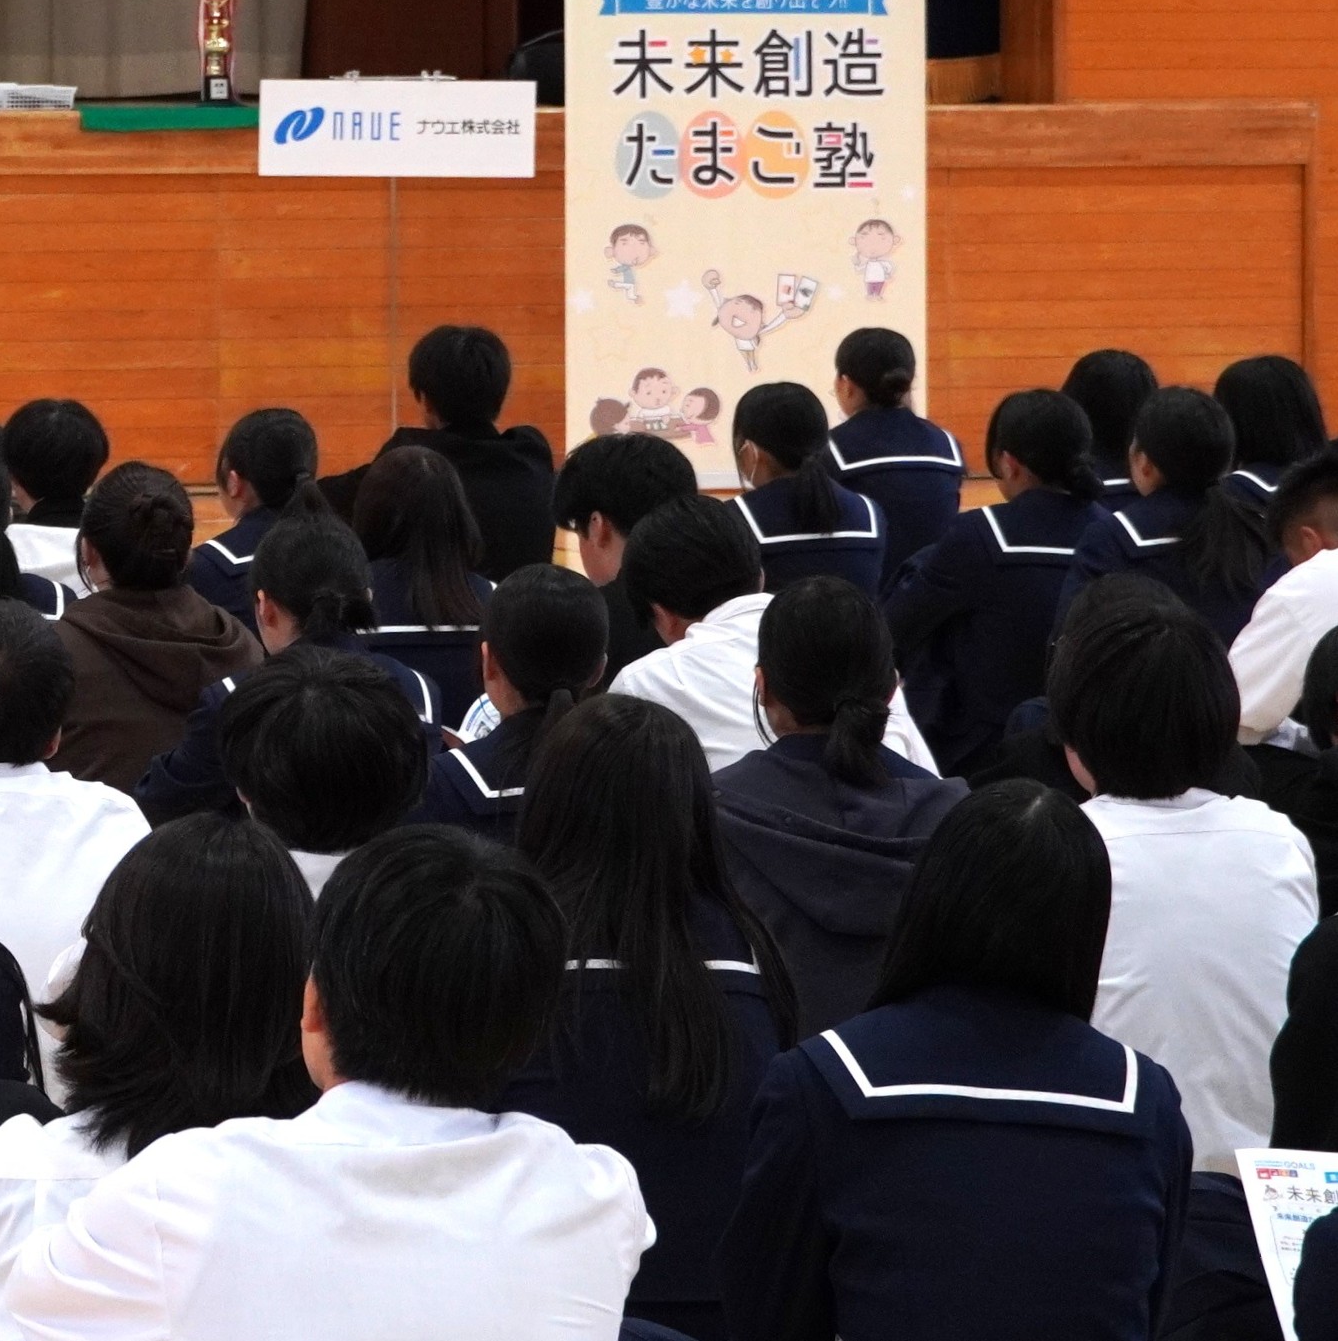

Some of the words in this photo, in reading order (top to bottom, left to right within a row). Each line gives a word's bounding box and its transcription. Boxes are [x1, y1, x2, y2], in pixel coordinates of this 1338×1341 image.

[612, 27, 885, 99] 未来創造
[416, 118, 521, 136] ナウエ株式会社
[625, 120, 875, 189] たまご塾
